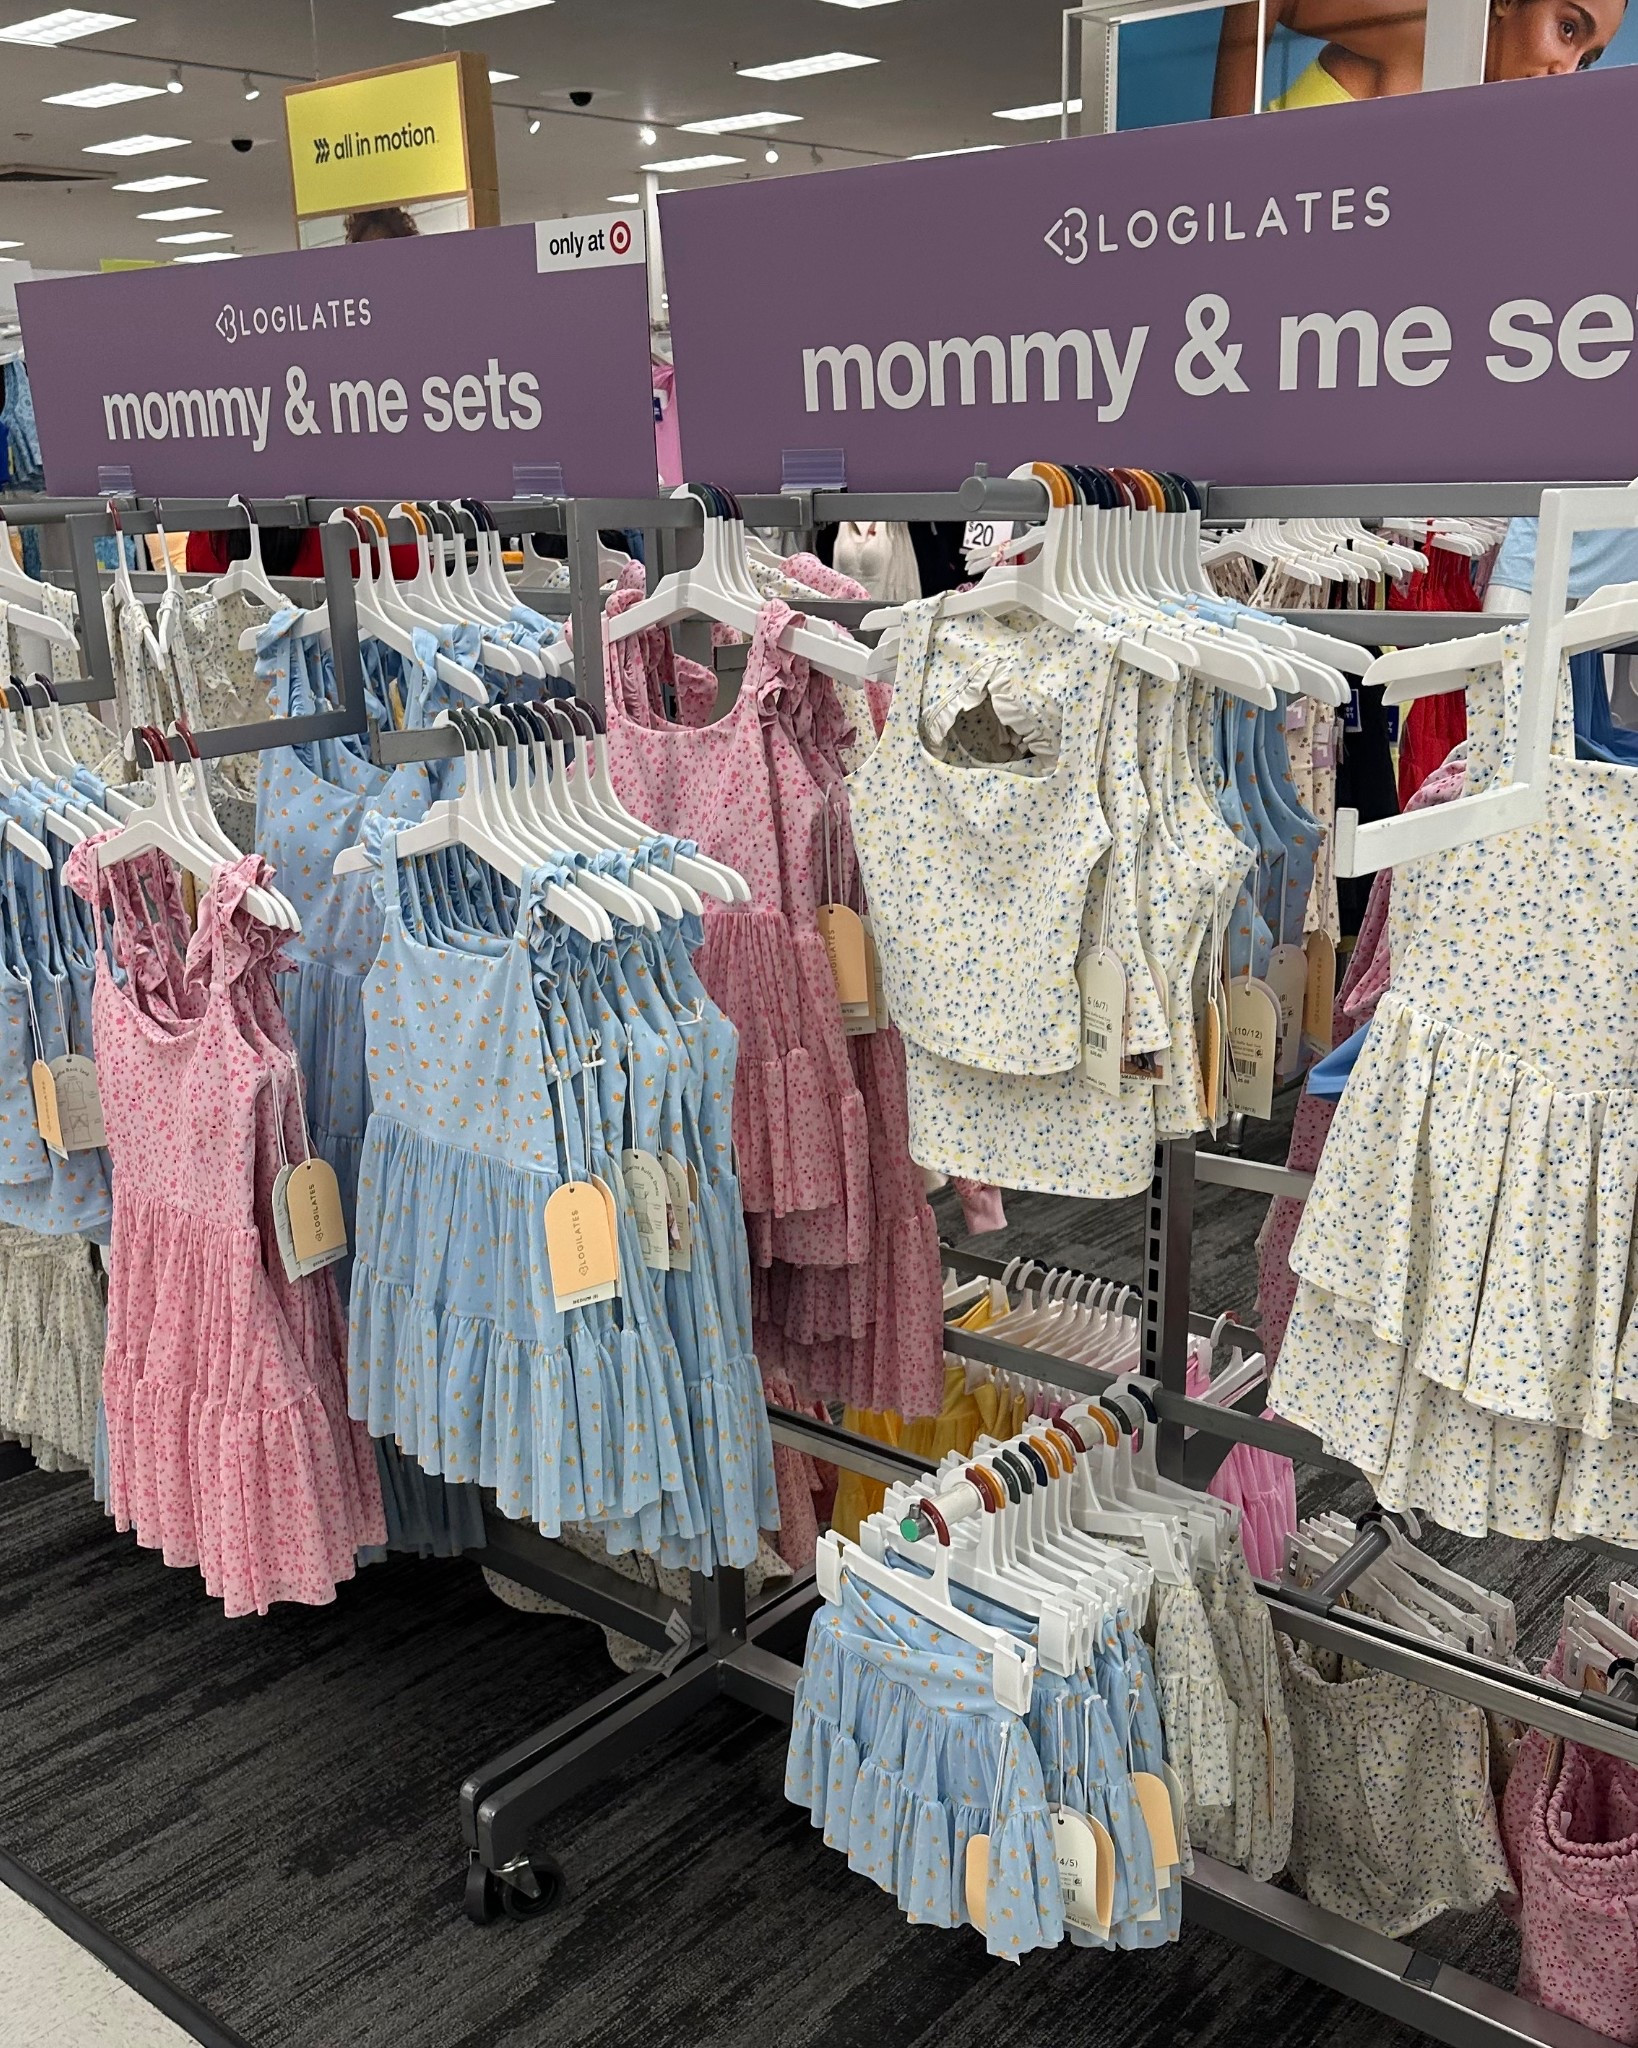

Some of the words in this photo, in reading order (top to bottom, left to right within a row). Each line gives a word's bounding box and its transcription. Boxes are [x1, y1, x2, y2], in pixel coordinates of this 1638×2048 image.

[334, 133, 353, 160] all
[355, 131, 371, 157] in
[374, 122, 436, 154] motion
[549, 231, 585, 259] only
[587, 229, 605, 252] at
[1043, 185, 1390, 265] BLOGILATES
[215, 297, 372, 344] BLOGILATES
[802, 325, 1150, 423] mommy
[1174, 293, 1250, 396] &
[1279, 305, 1452, 391] me
[1485, 294, 1638, 383] se
[102, 386, 271, 452] mommy
[284, 366, 321, 436] &
[329, 378, 408, 434] me
[421, 358, 542, 432] sets
[968, 521, 994, 547] $20
[1234, 1026, 1263, 1040] (10/12)
[1056, 1857, 1078, 1868] 4/5)
